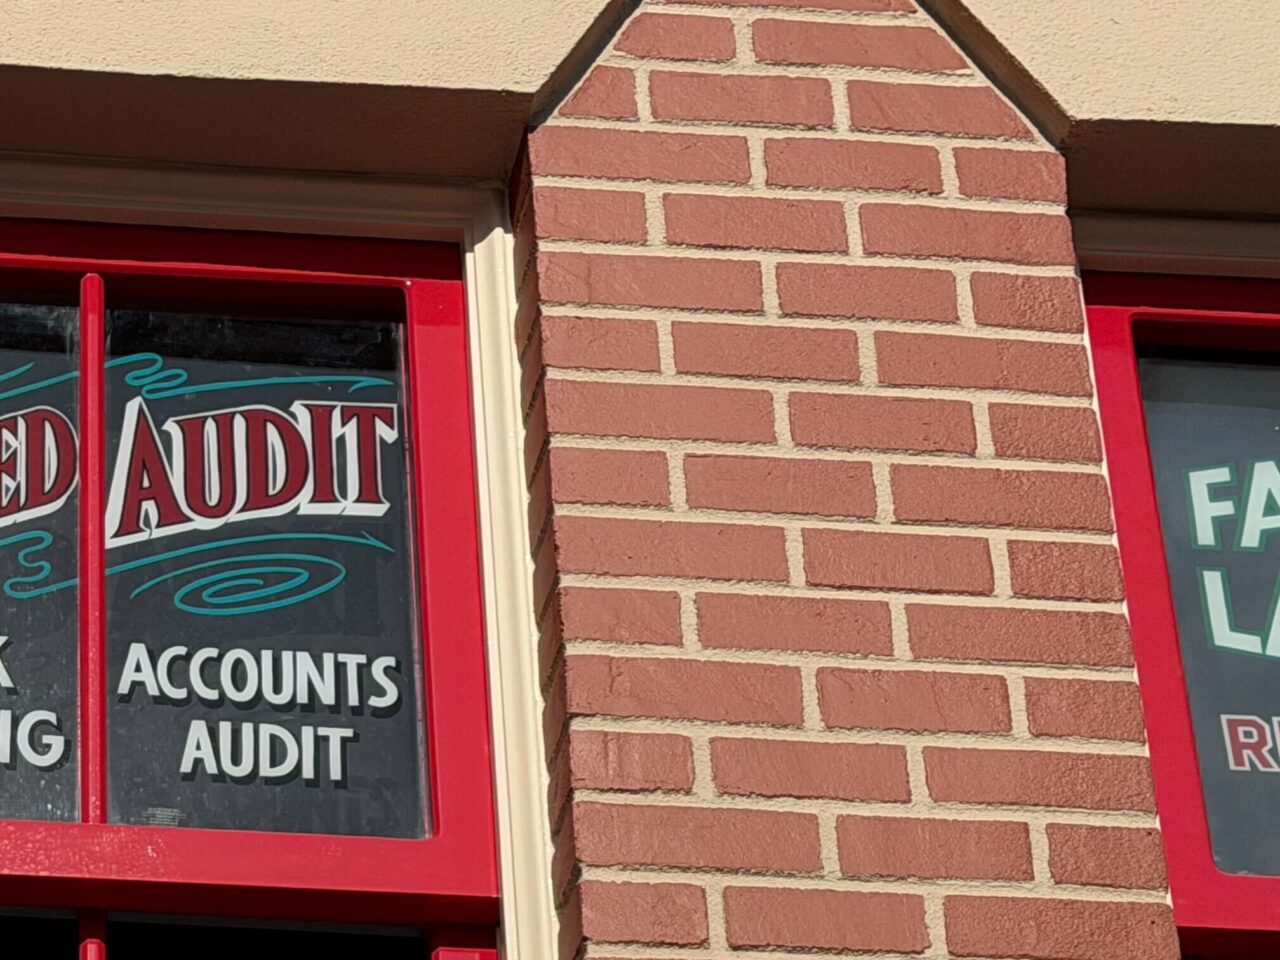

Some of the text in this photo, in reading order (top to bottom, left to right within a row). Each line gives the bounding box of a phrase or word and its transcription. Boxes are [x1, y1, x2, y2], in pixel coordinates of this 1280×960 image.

[105, 396, 398, 549] AUDIT
[117, 643, 400, 708] ACCOUNTS
[179, 720, 355, 782] AUDIT
